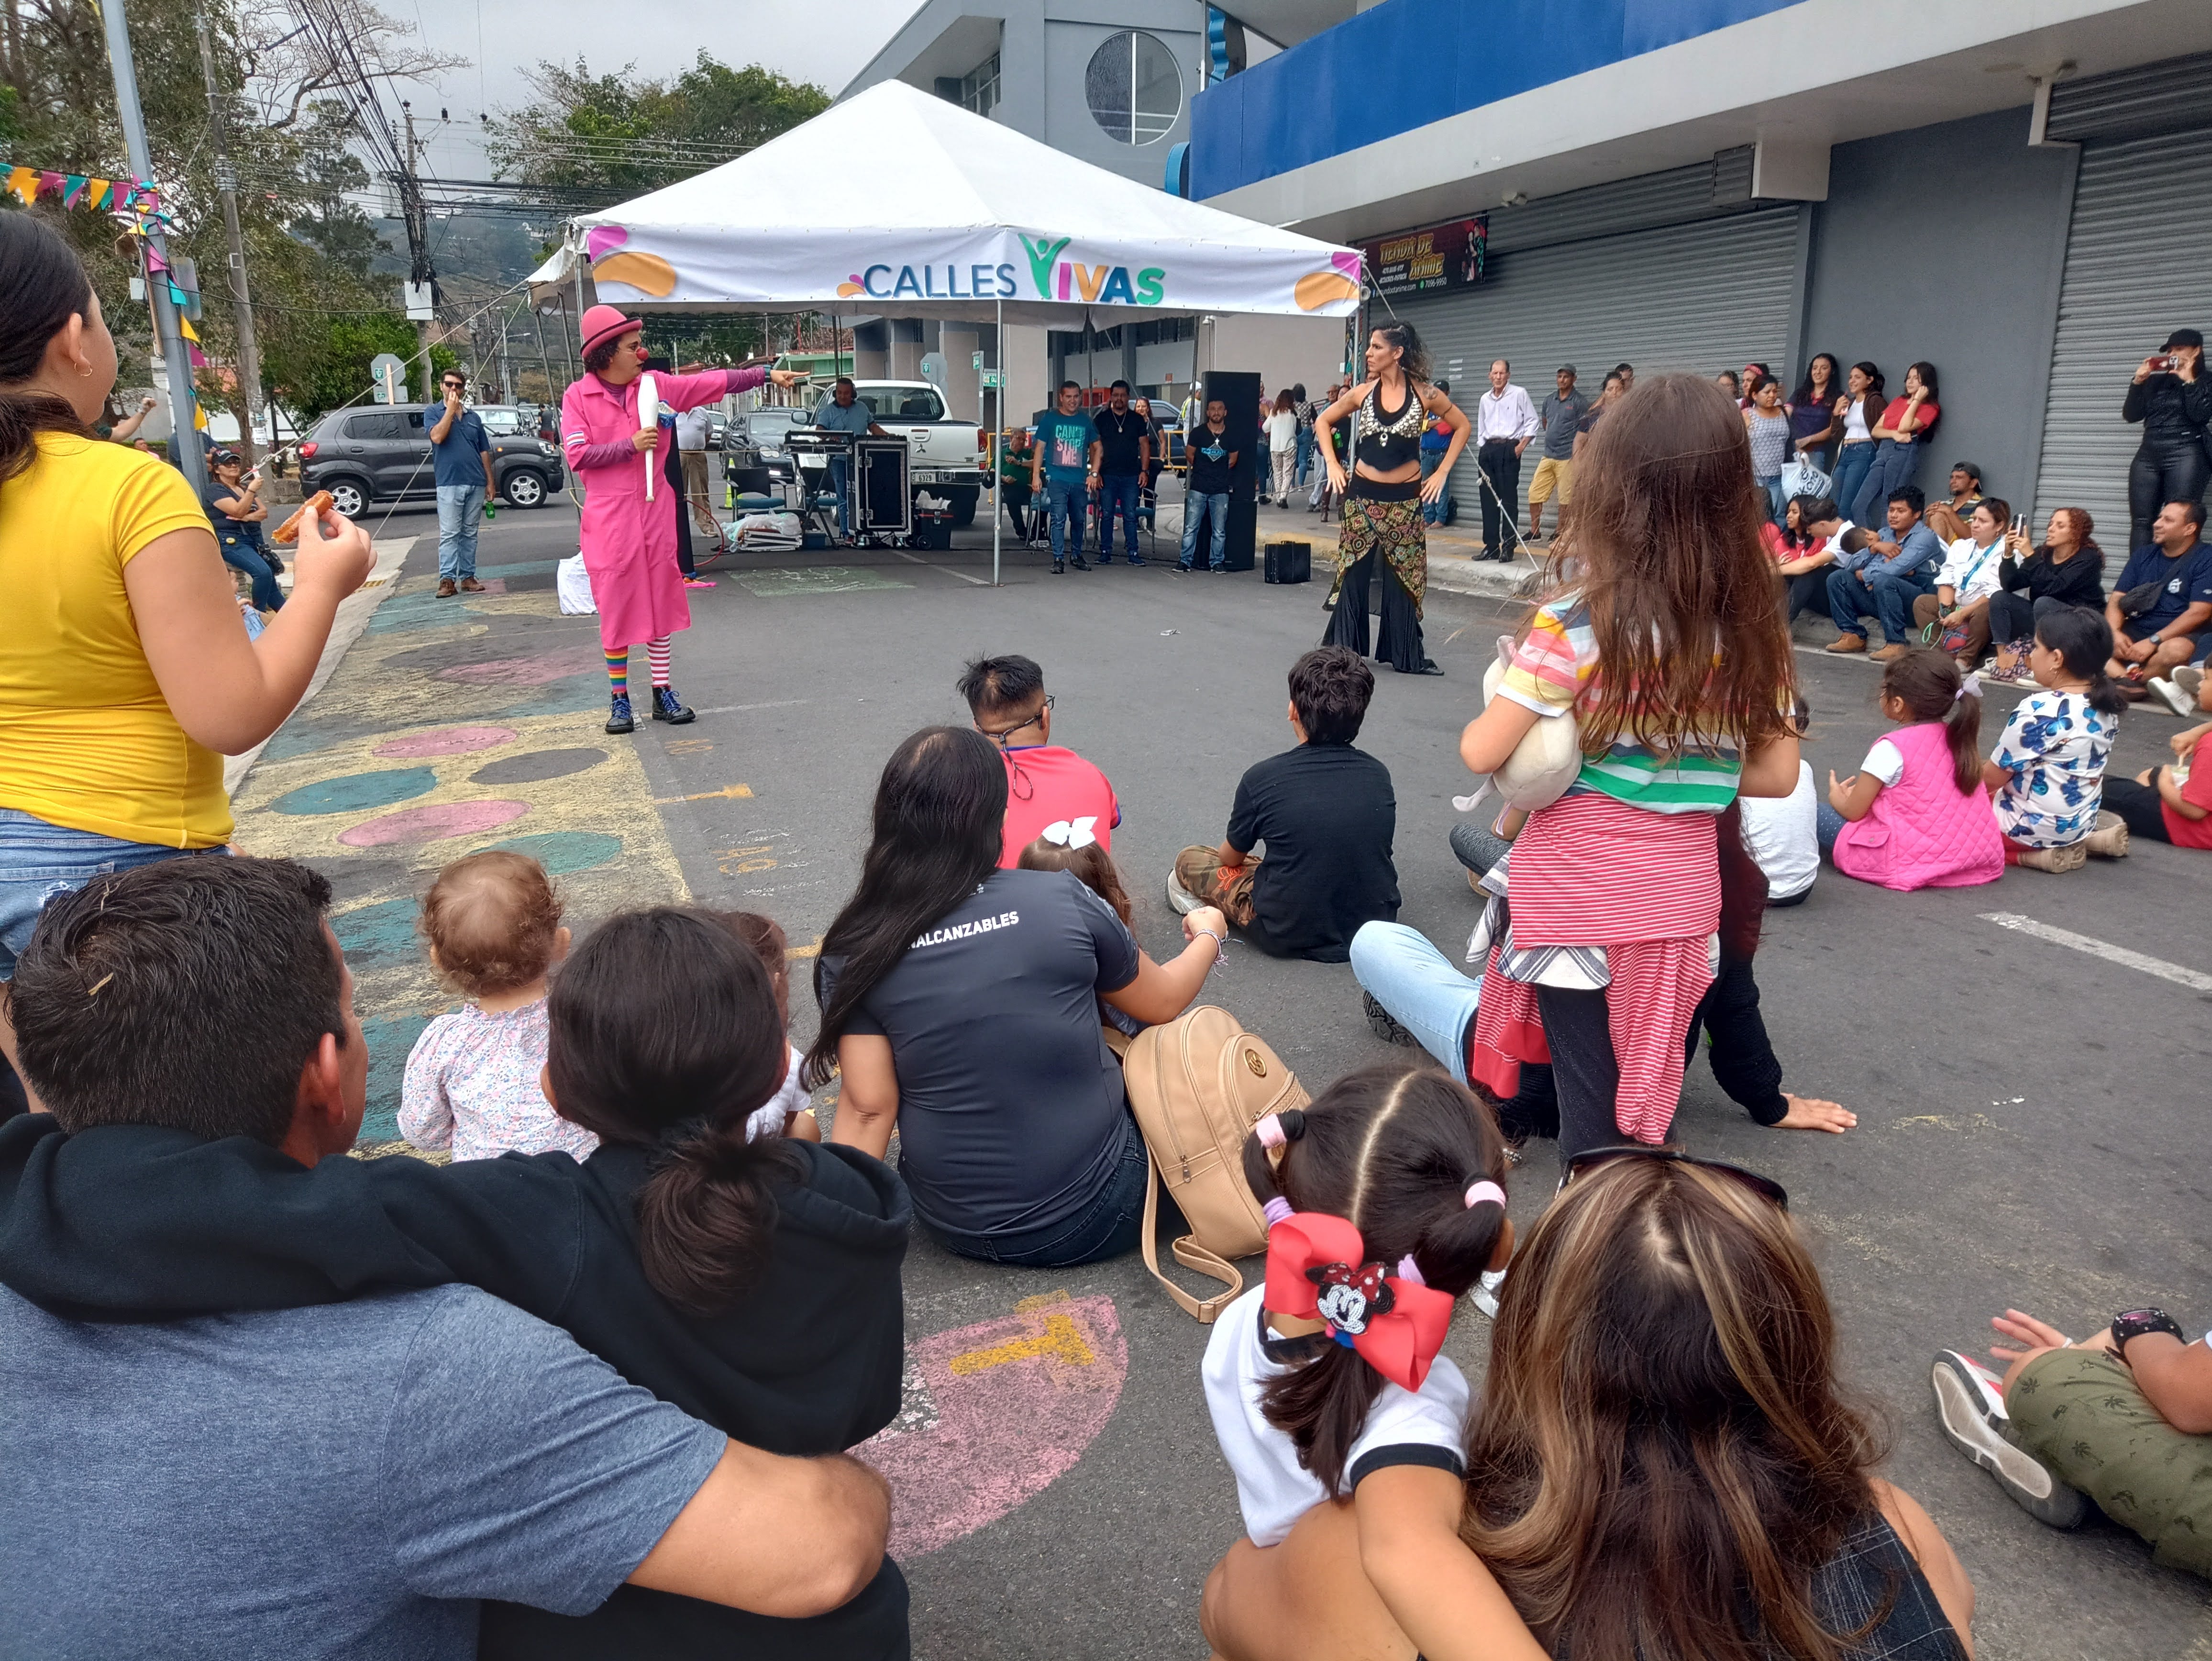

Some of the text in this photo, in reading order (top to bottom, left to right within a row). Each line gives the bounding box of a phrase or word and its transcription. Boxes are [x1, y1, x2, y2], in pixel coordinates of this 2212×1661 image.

[1380, 233, 1434, 265] TIENDA DE
[1409, 253, 1445, 280] ANIME
[863, 264, 1016, 299] CALLES
[1057, 438, 1081, 454] STOP
[1062, 450, 1077, 465] ME
